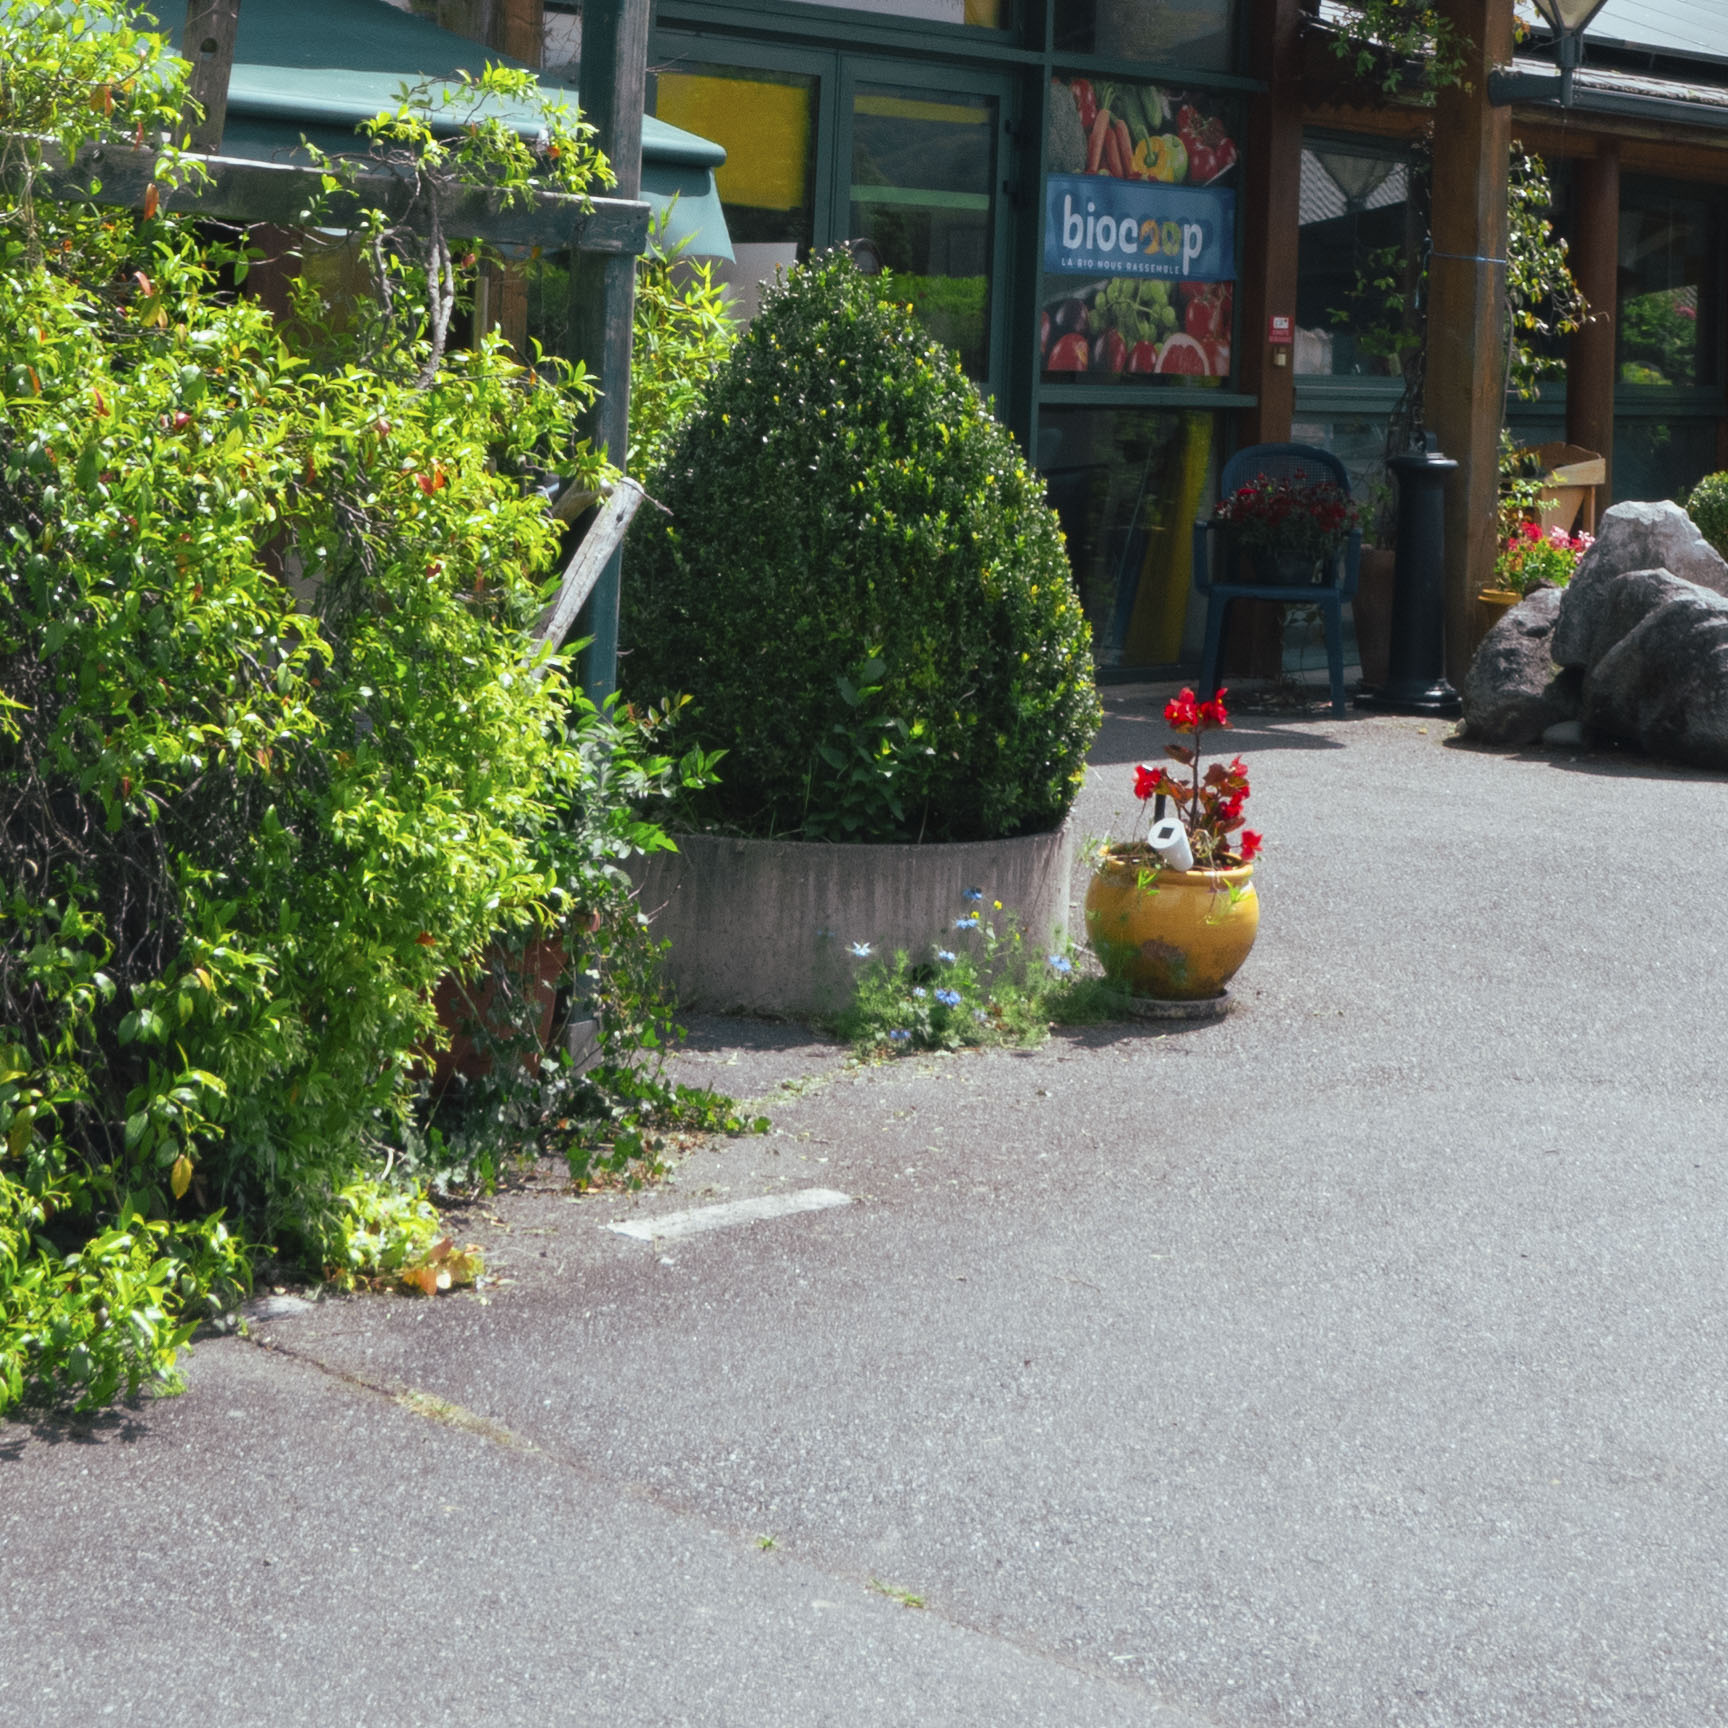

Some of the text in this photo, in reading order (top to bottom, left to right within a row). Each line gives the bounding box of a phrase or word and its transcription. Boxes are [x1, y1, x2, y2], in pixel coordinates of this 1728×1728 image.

[1062, 193, 1204, 277] biocoop
[1060, 257, 1181, 275] LA BIO NOUS RASSEMBLE
